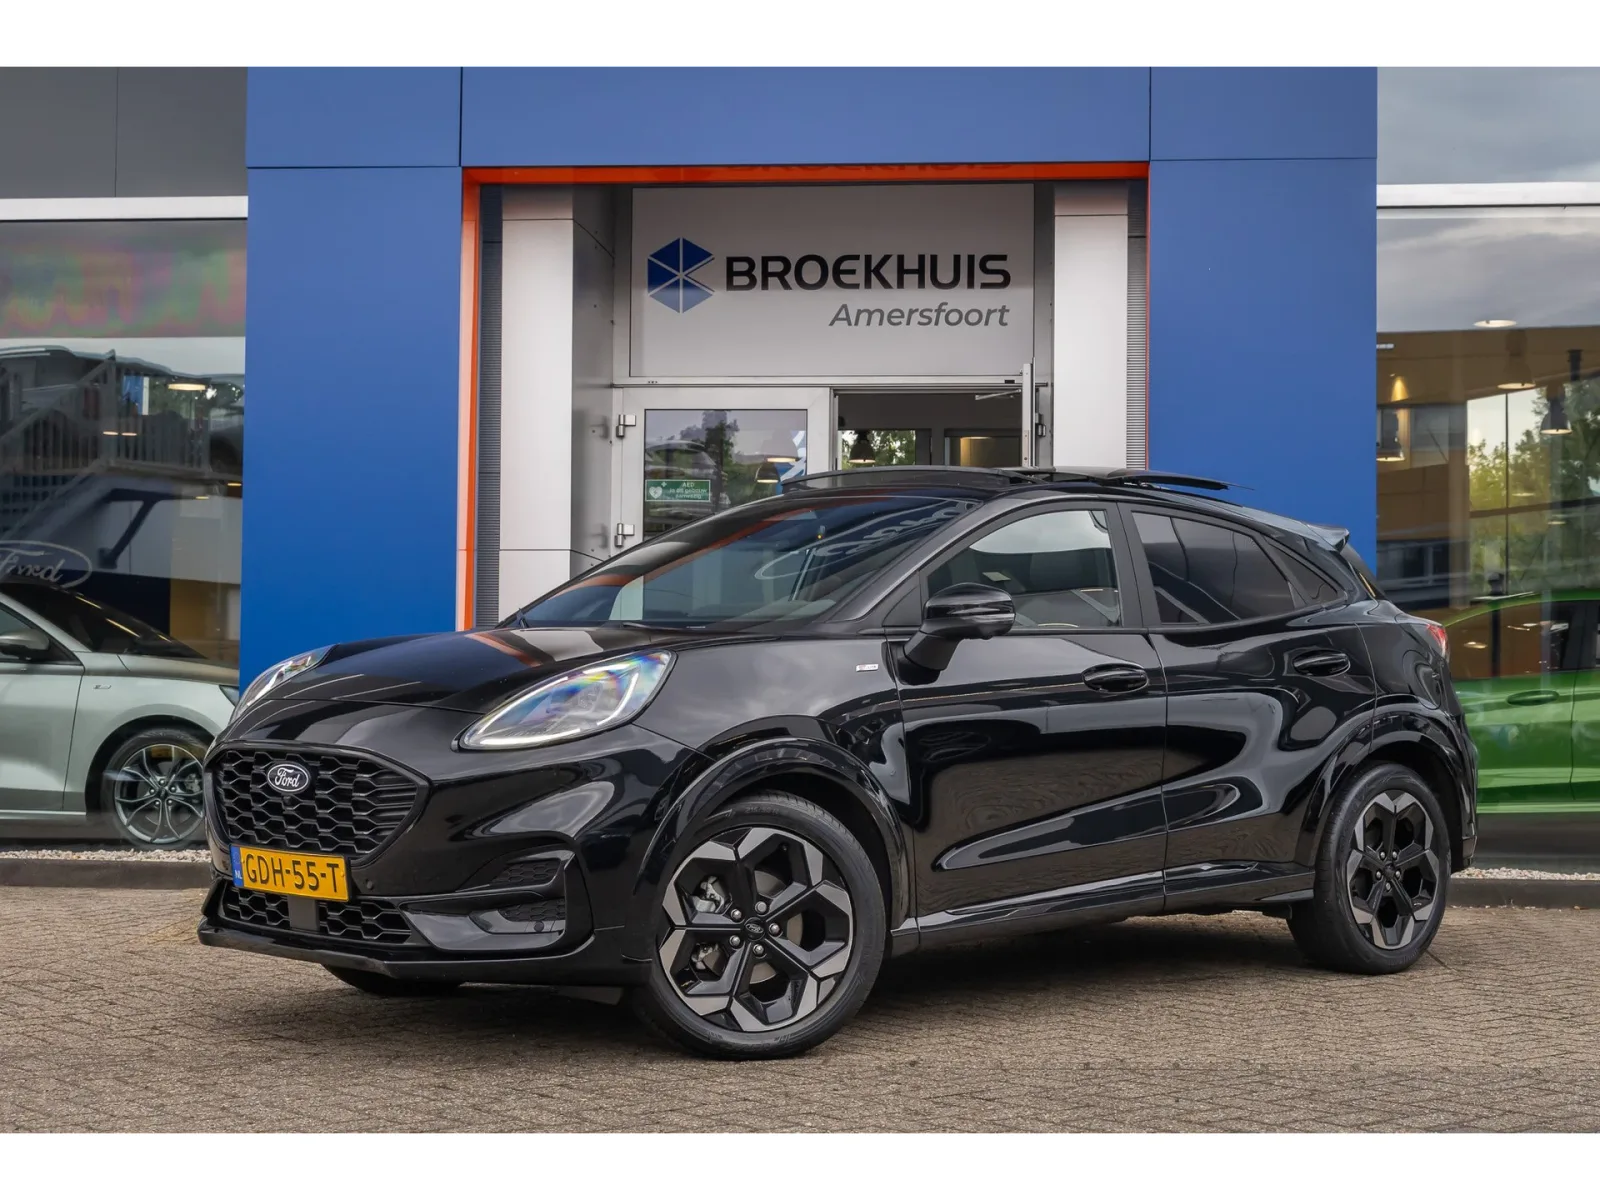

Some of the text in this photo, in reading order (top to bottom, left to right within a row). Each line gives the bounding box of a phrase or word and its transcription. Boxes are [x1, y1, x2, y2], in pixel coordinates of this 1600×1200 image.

[726, 254, 1010, 291] BROEKHUIS
[829, 302, 1010, 326] Amersfoort
[275, 767, 300, 788] Ford
[234, 853, 339, 893] NL GDH-55-T
